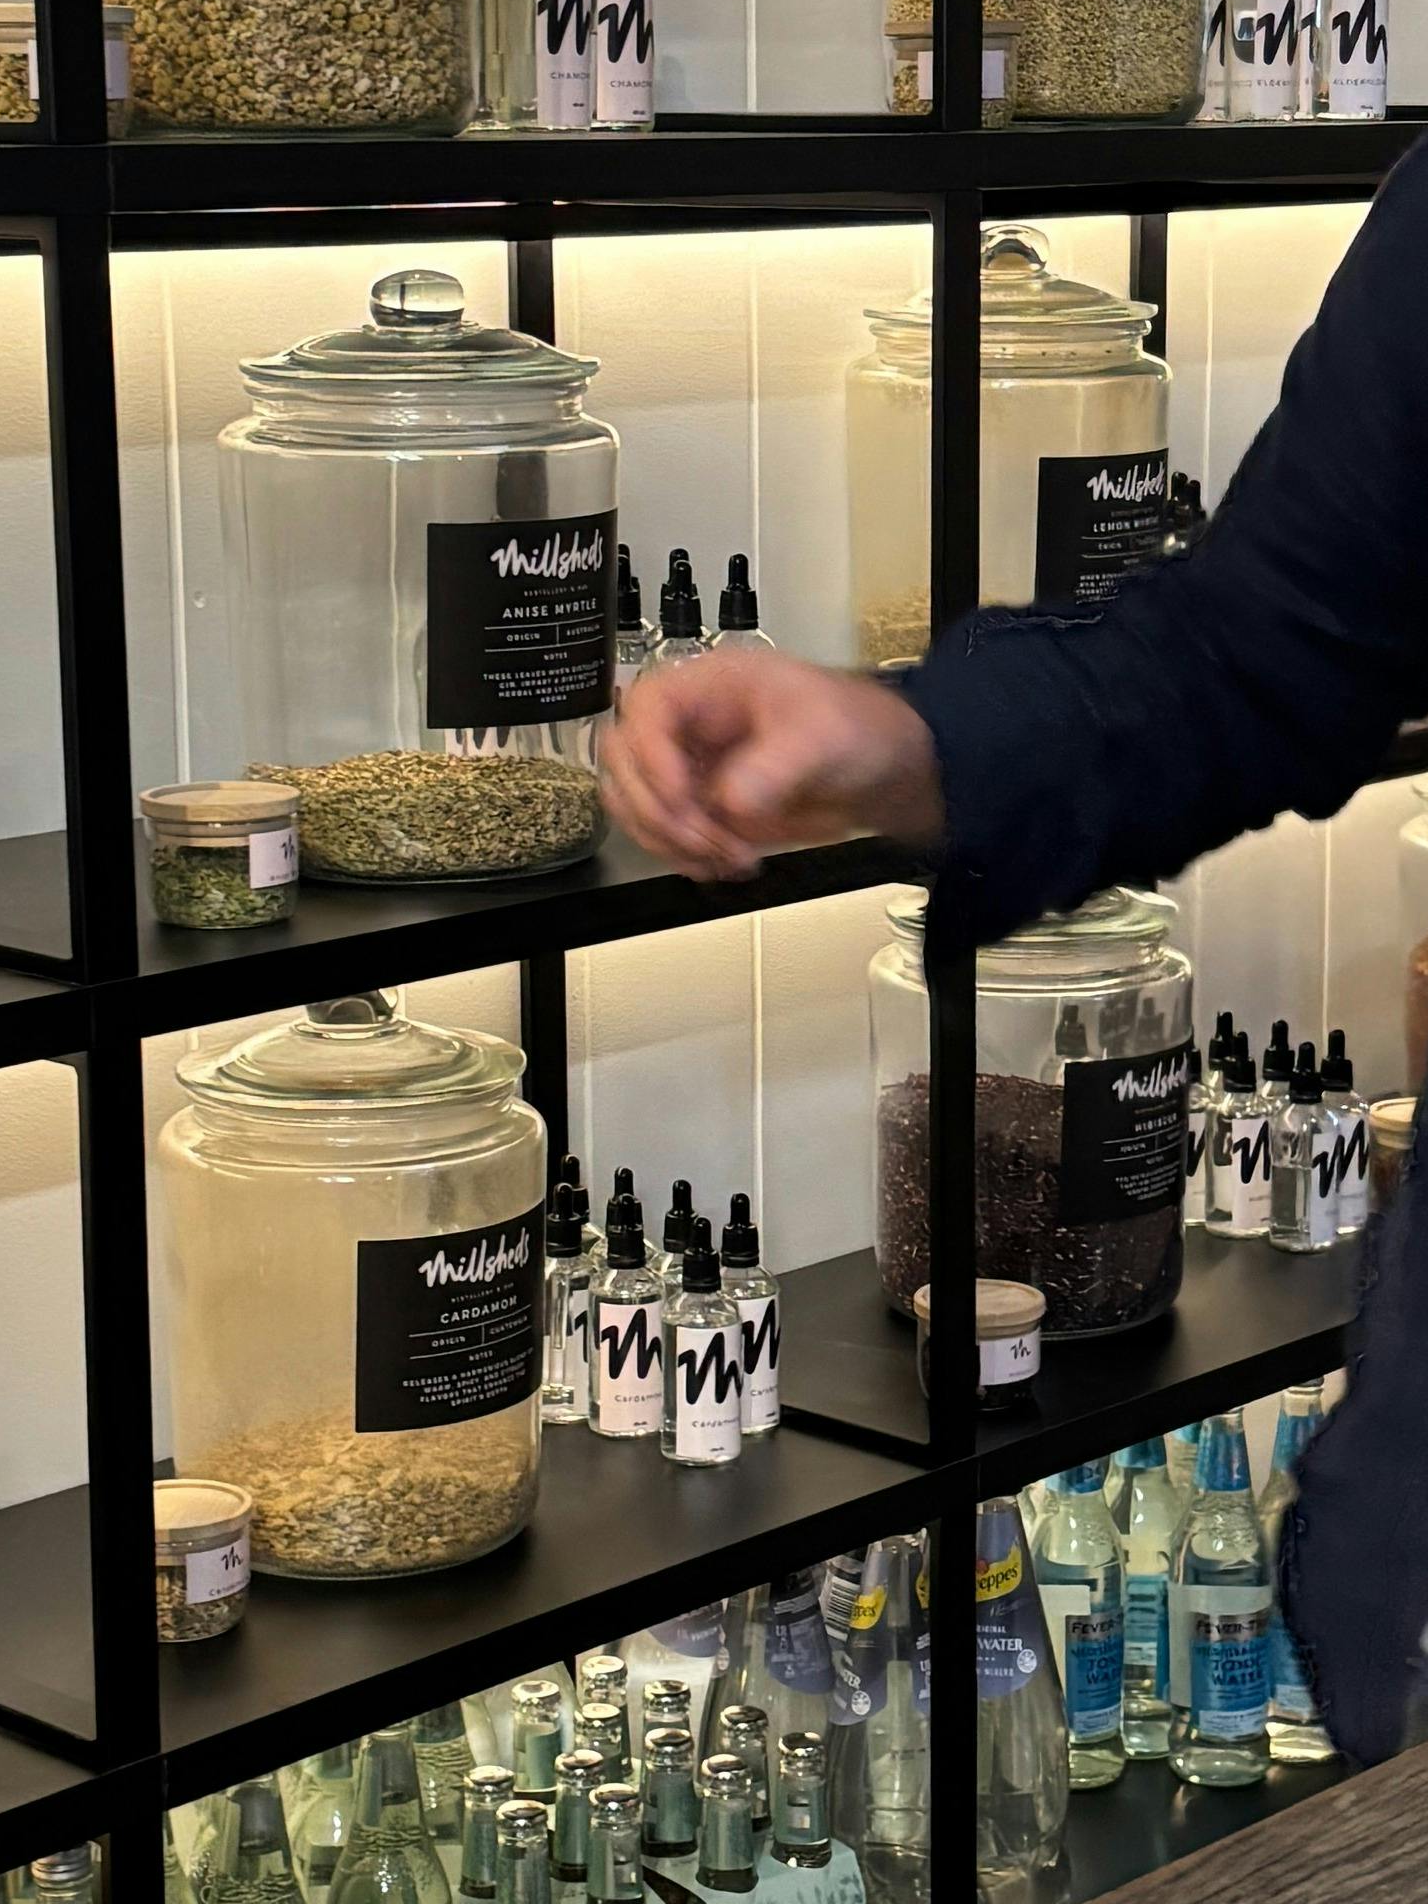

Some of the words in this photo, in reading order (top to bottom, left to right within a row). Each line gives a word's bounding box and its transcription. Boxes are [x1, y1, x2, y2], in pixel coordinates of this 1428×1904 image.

[1093, 521, 1131, 533] LEMON
[502, 605, 548, 619] ANISE
[555, 598, 596, 615] MYRTLE
[507, 633, 540, 642] ORIGIN
[440, 1295, 518, 1324] CARDAMOM
[431, 1336, 466, 1347] ORIGIN
